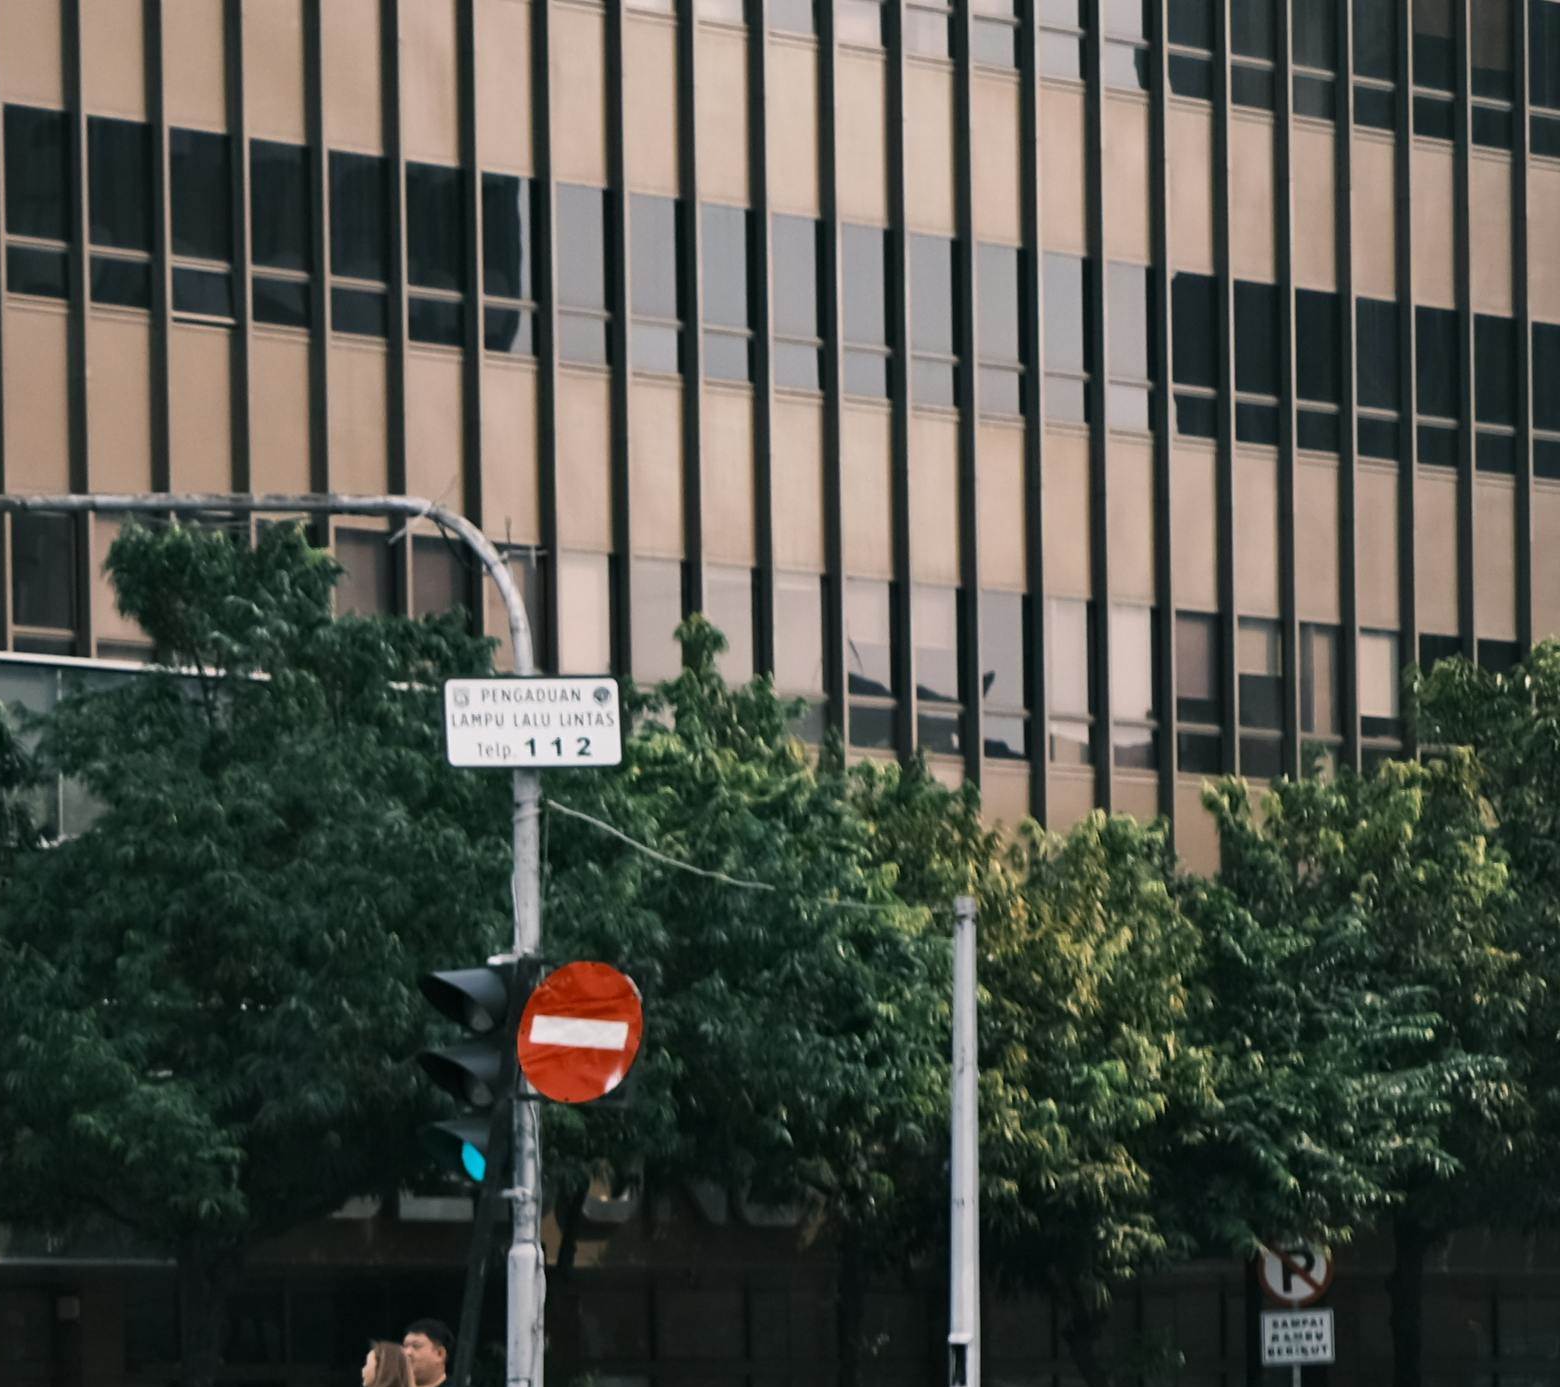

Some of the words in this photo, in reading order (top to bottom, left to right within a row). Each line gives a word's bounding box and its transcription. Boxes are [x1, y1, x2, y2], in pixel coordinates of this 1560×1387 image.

[481, 687, 581, 704] PENGADUAN
[451, 711, 504, 728] LAMPU
[513, 711, 551, 727] LALU
[559, 710, 615, 727] LINTAS
